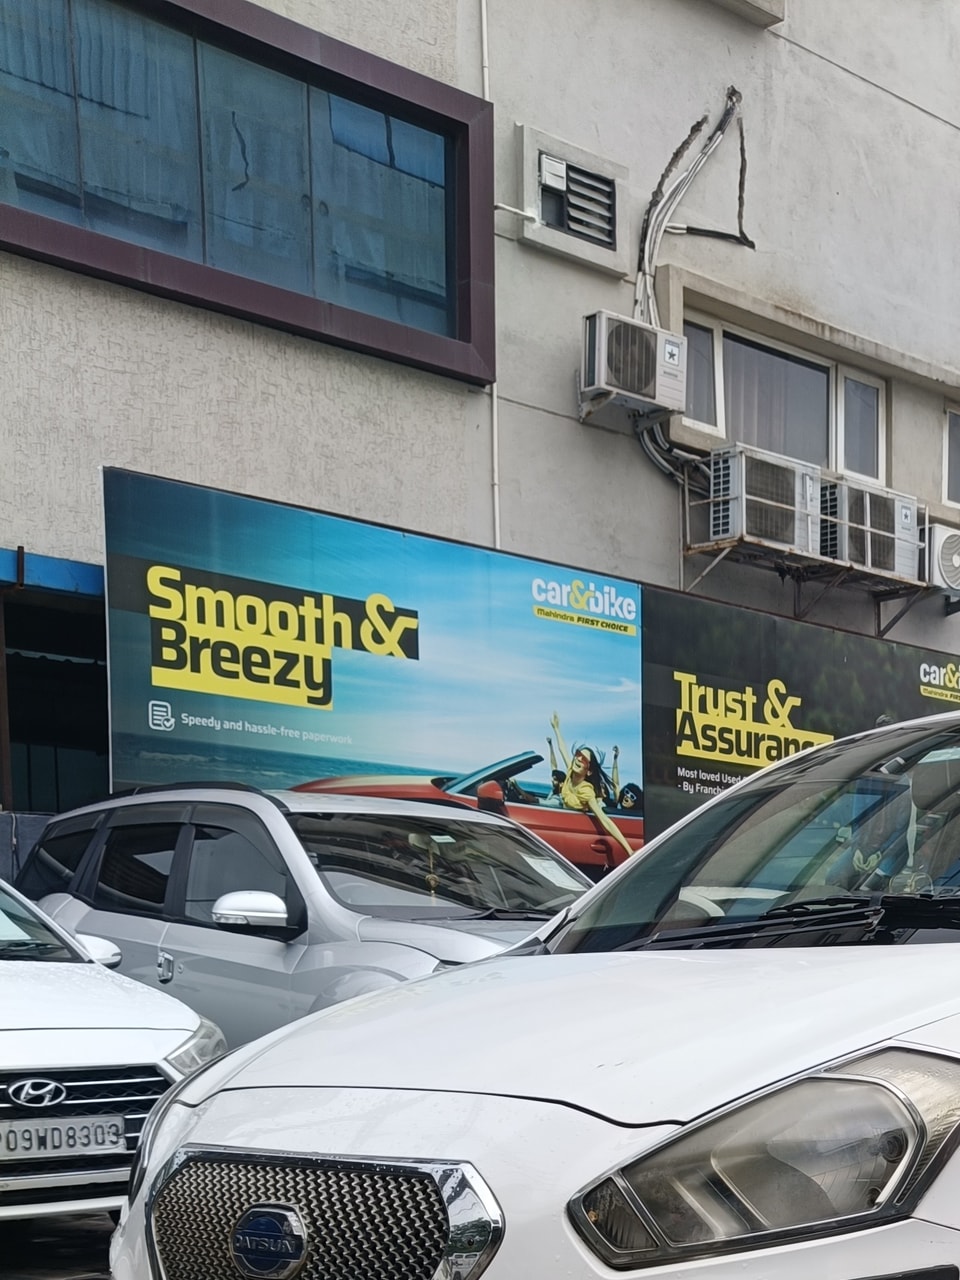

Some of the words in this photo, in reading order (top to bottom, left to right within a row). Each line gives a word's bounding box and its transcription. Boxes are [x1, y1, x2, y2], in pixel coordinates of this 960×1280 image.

[147, 565, 352, 649] Smooth
[532, 578, 636, 620] car&bike
[536, 608, 574, 622] Mahindra
[576, 616, 600, 627] FIRST
[600, 621, 629, 632] CHOICE
[151, 620, 332, 706] Breezy
[673, 671, 757, 722] Trust
[763, 679, 802, 729] &
[180, 713, 221, 731] Speedy
[222, 718, 242, 731] and
[244, 720, 300, 739] hassle-free
[302, 730, 353, 745] paperwork
[677, 711, 820, 761] Assuran
[677, 766, 697, 779] Most
[699, 770, 721, 782] loved
[683, 781, 694, 794] By
[0, 1123, 120, 1152] 09WD8303
